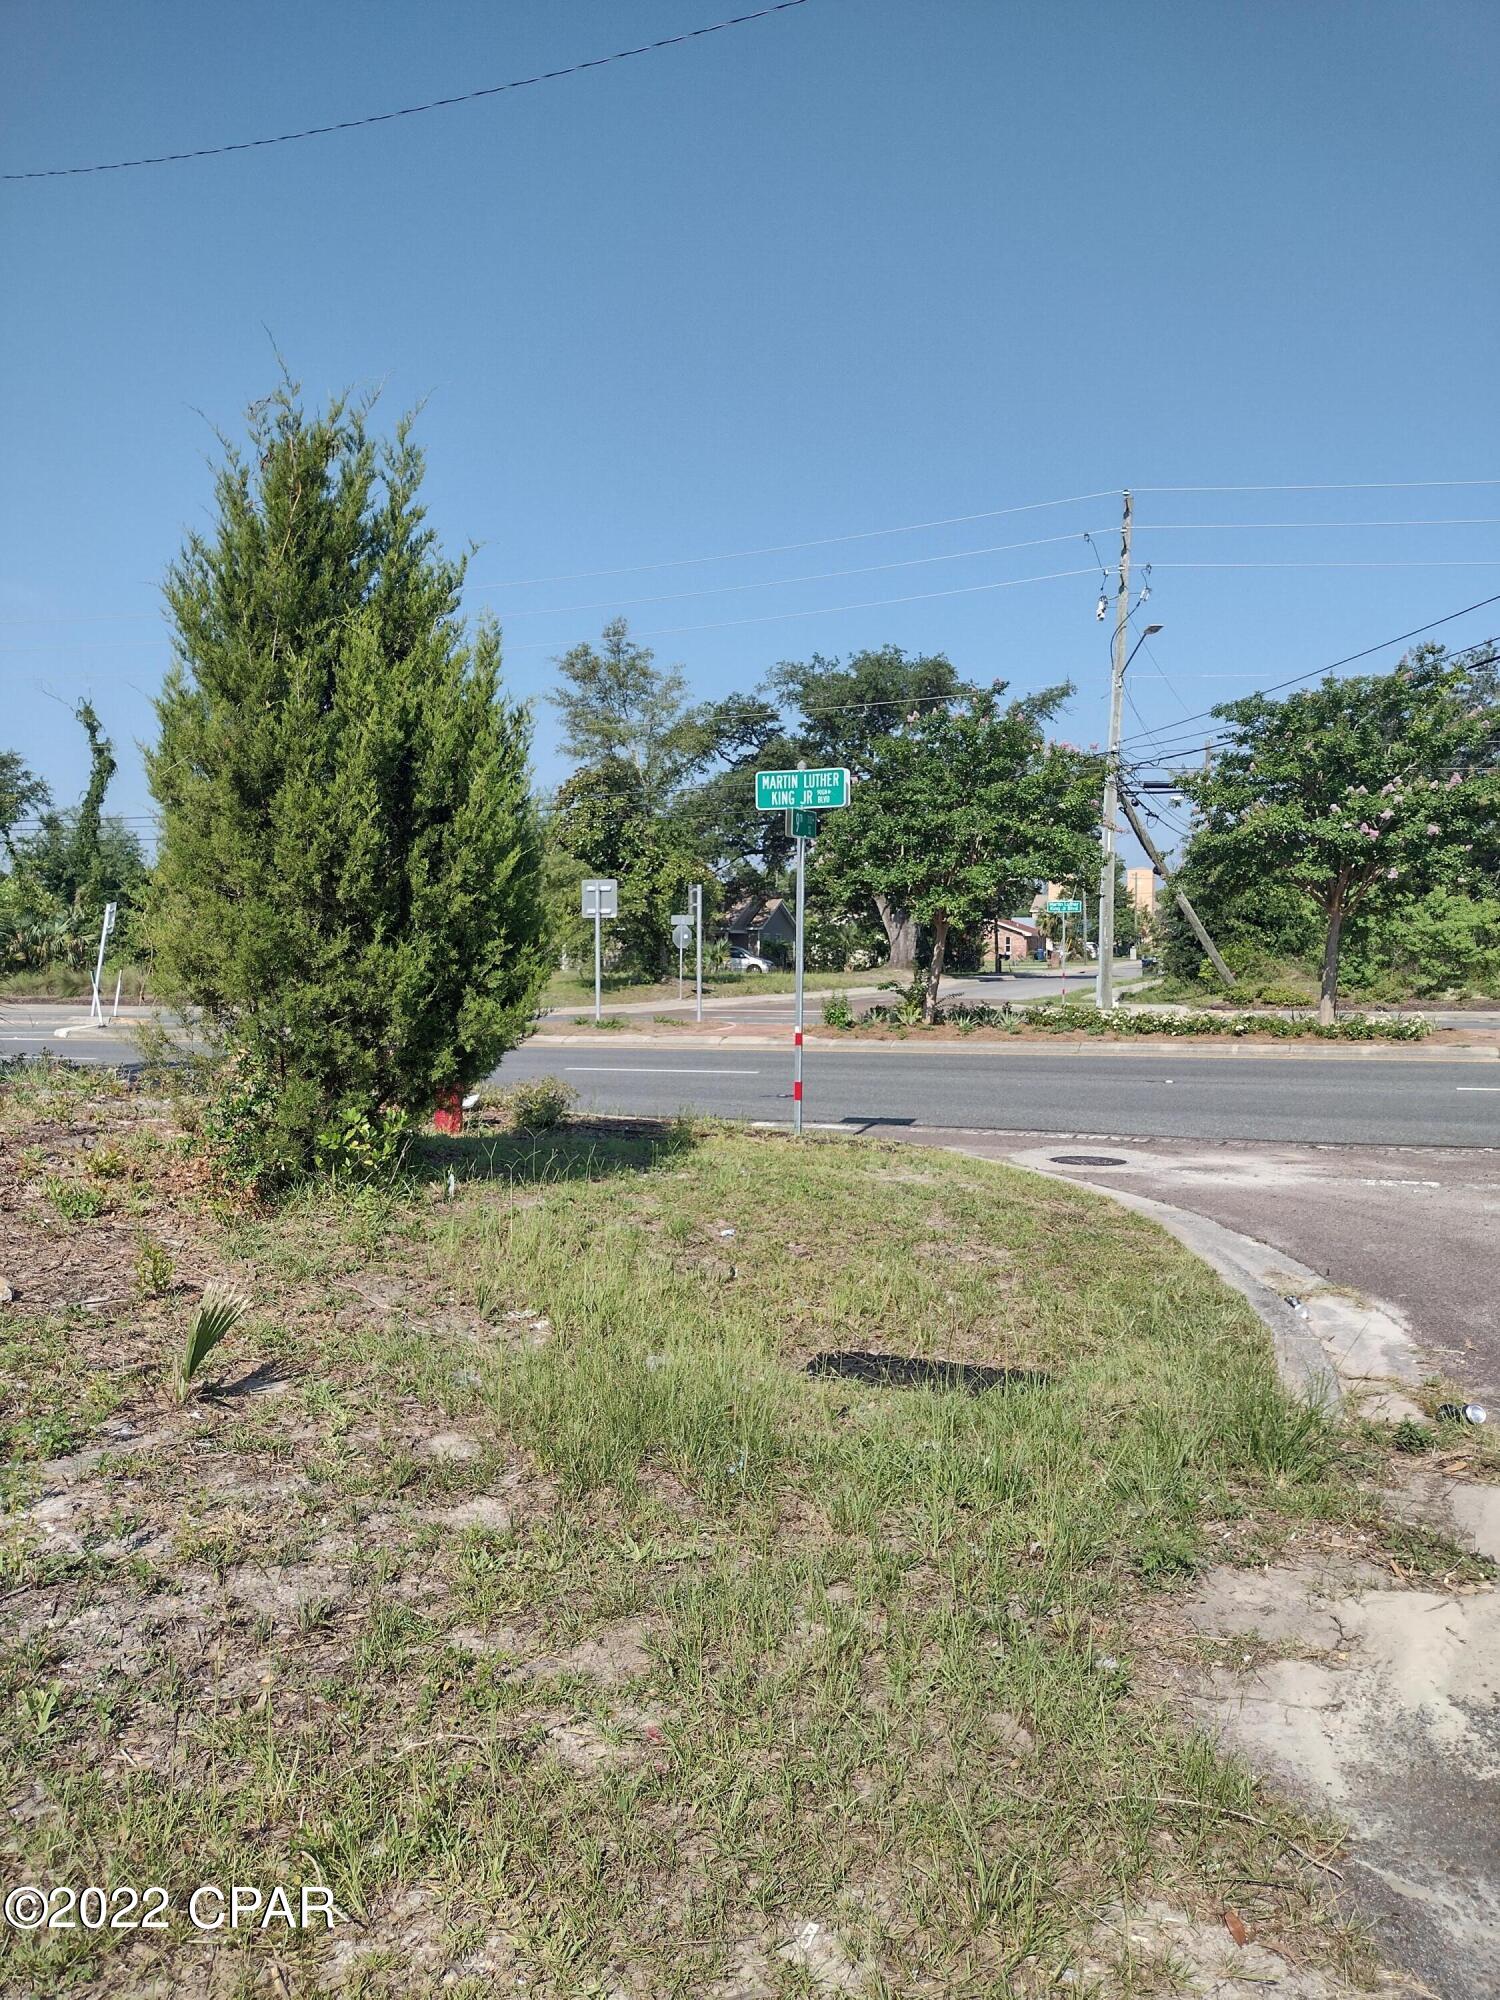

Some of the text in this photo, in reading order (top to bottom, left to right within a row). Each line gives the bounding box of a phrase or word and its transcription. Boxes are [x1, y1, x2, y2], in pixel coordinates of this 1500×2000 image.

[762, 772, 839, 790] MARTIN LUTHER
[771, 790, 795, 806] KING
[800, 790, 813, 804] JR
[817, 795, 830, 804] BLVD
